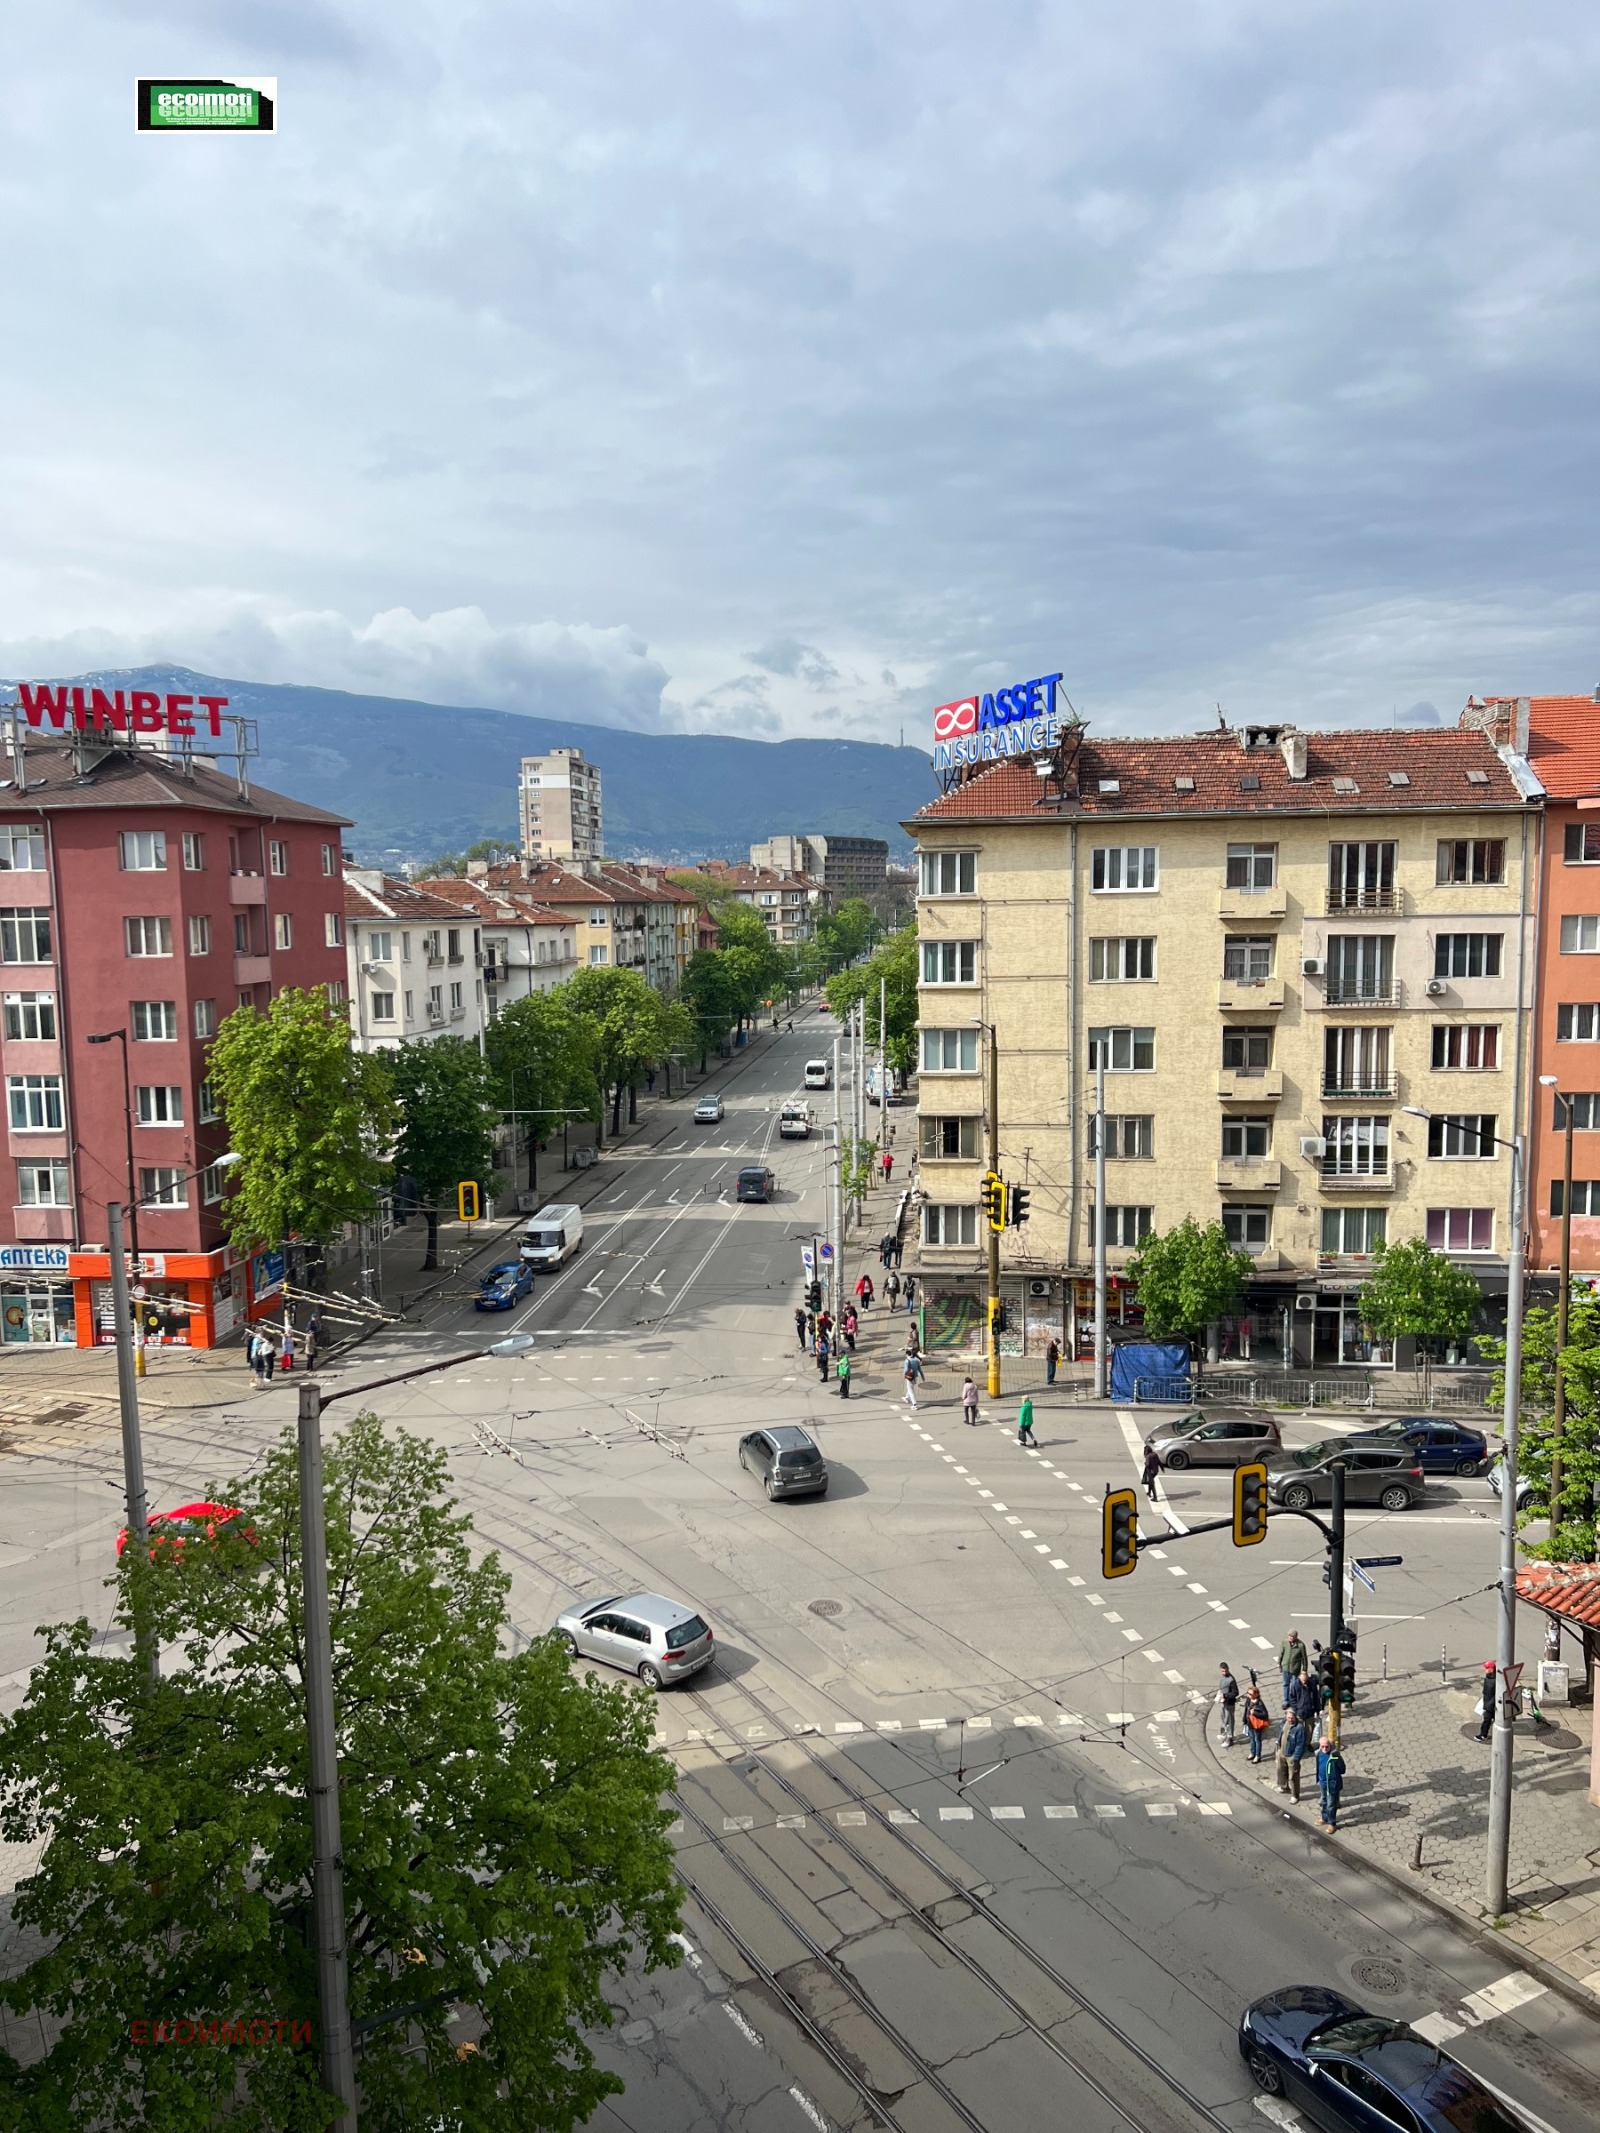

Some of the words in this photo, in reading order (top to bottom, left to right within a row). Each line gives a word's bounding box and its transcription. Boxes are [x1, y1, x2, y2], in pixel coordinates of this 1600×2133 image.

[18, 683, 229, 736] WINBET
[978, 672, 1063, 731] ASSET
[933, 717, 1059, 771] INSURANCE
[1, 1248, 67, 1265] АПТЕКА
